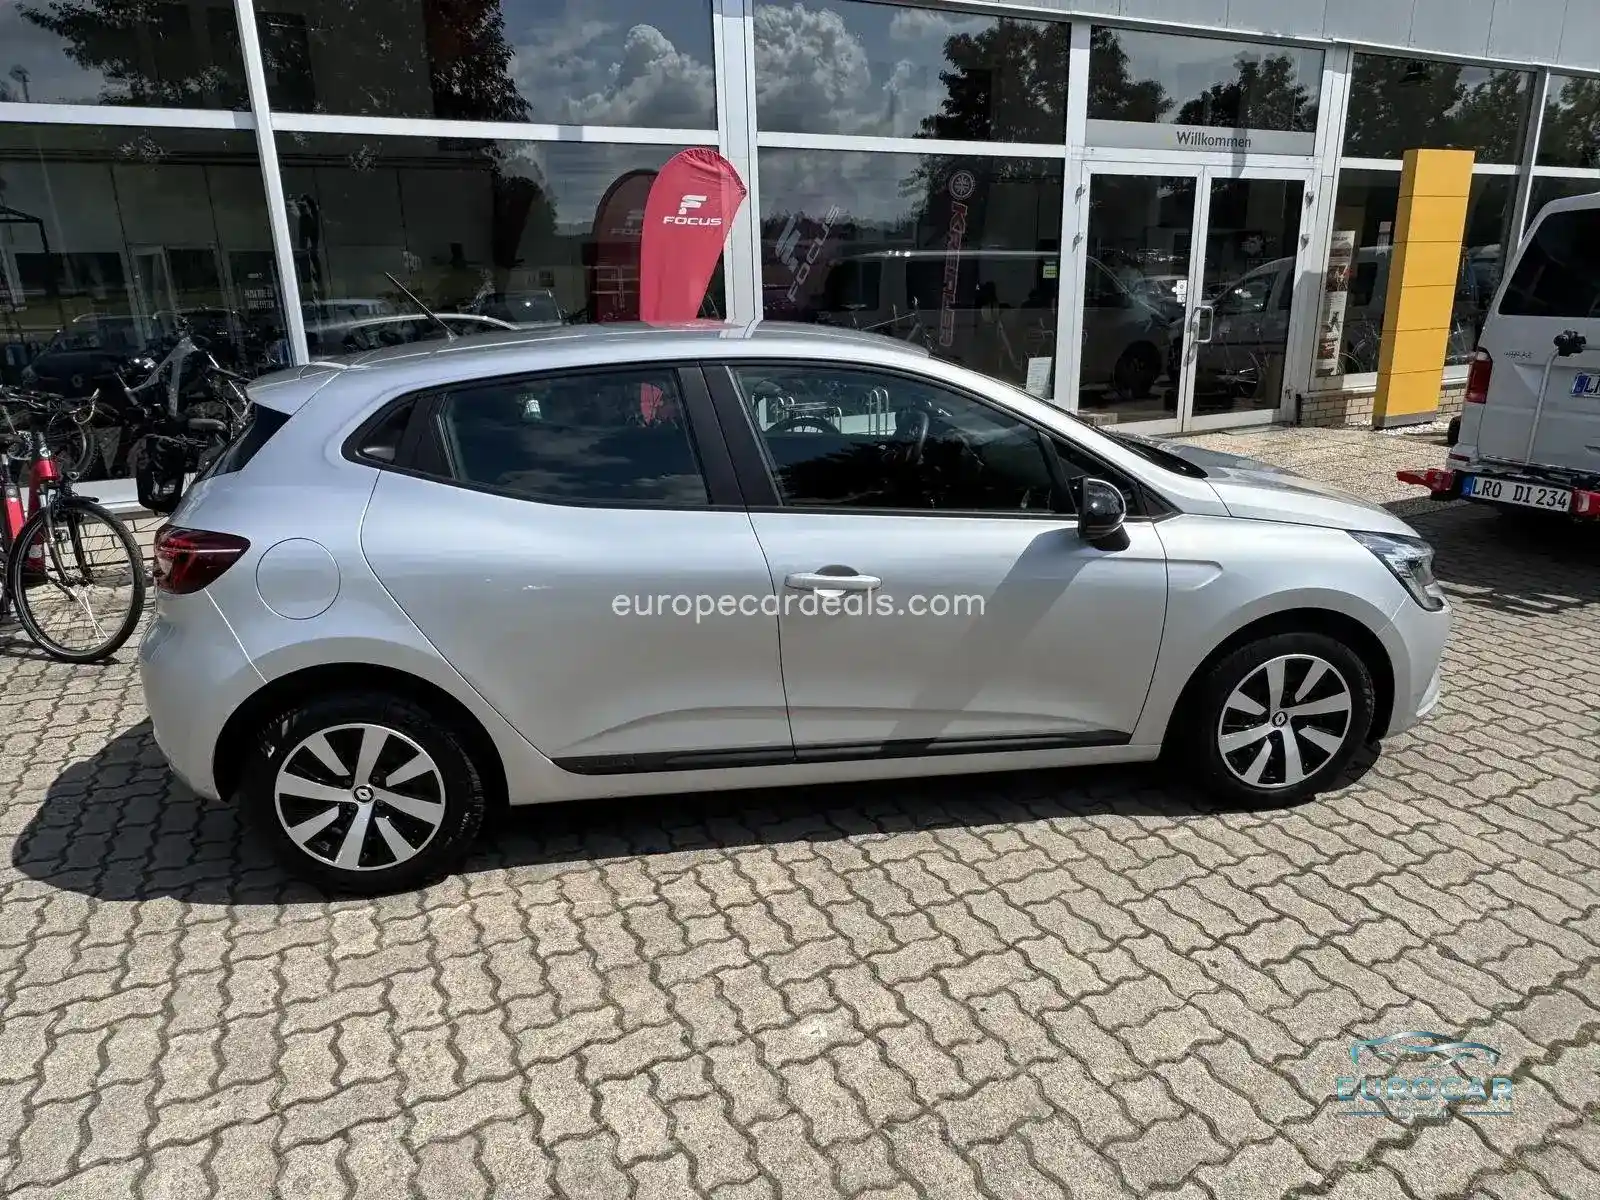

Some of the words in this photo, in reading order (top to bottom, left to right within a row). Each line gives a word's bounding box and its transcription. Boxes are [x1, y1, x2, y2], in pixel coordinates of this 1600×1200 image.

[1176, 130, 1252, 148] Willkommen
[662, 215, 722, 226] FOCUS
[786, 203, 840, 303] FOCUS
[1472, 478, 1502, 498] LRO
[1512, 484, 1532, 504] DI
[1535, 488, 1568, 509] 234
